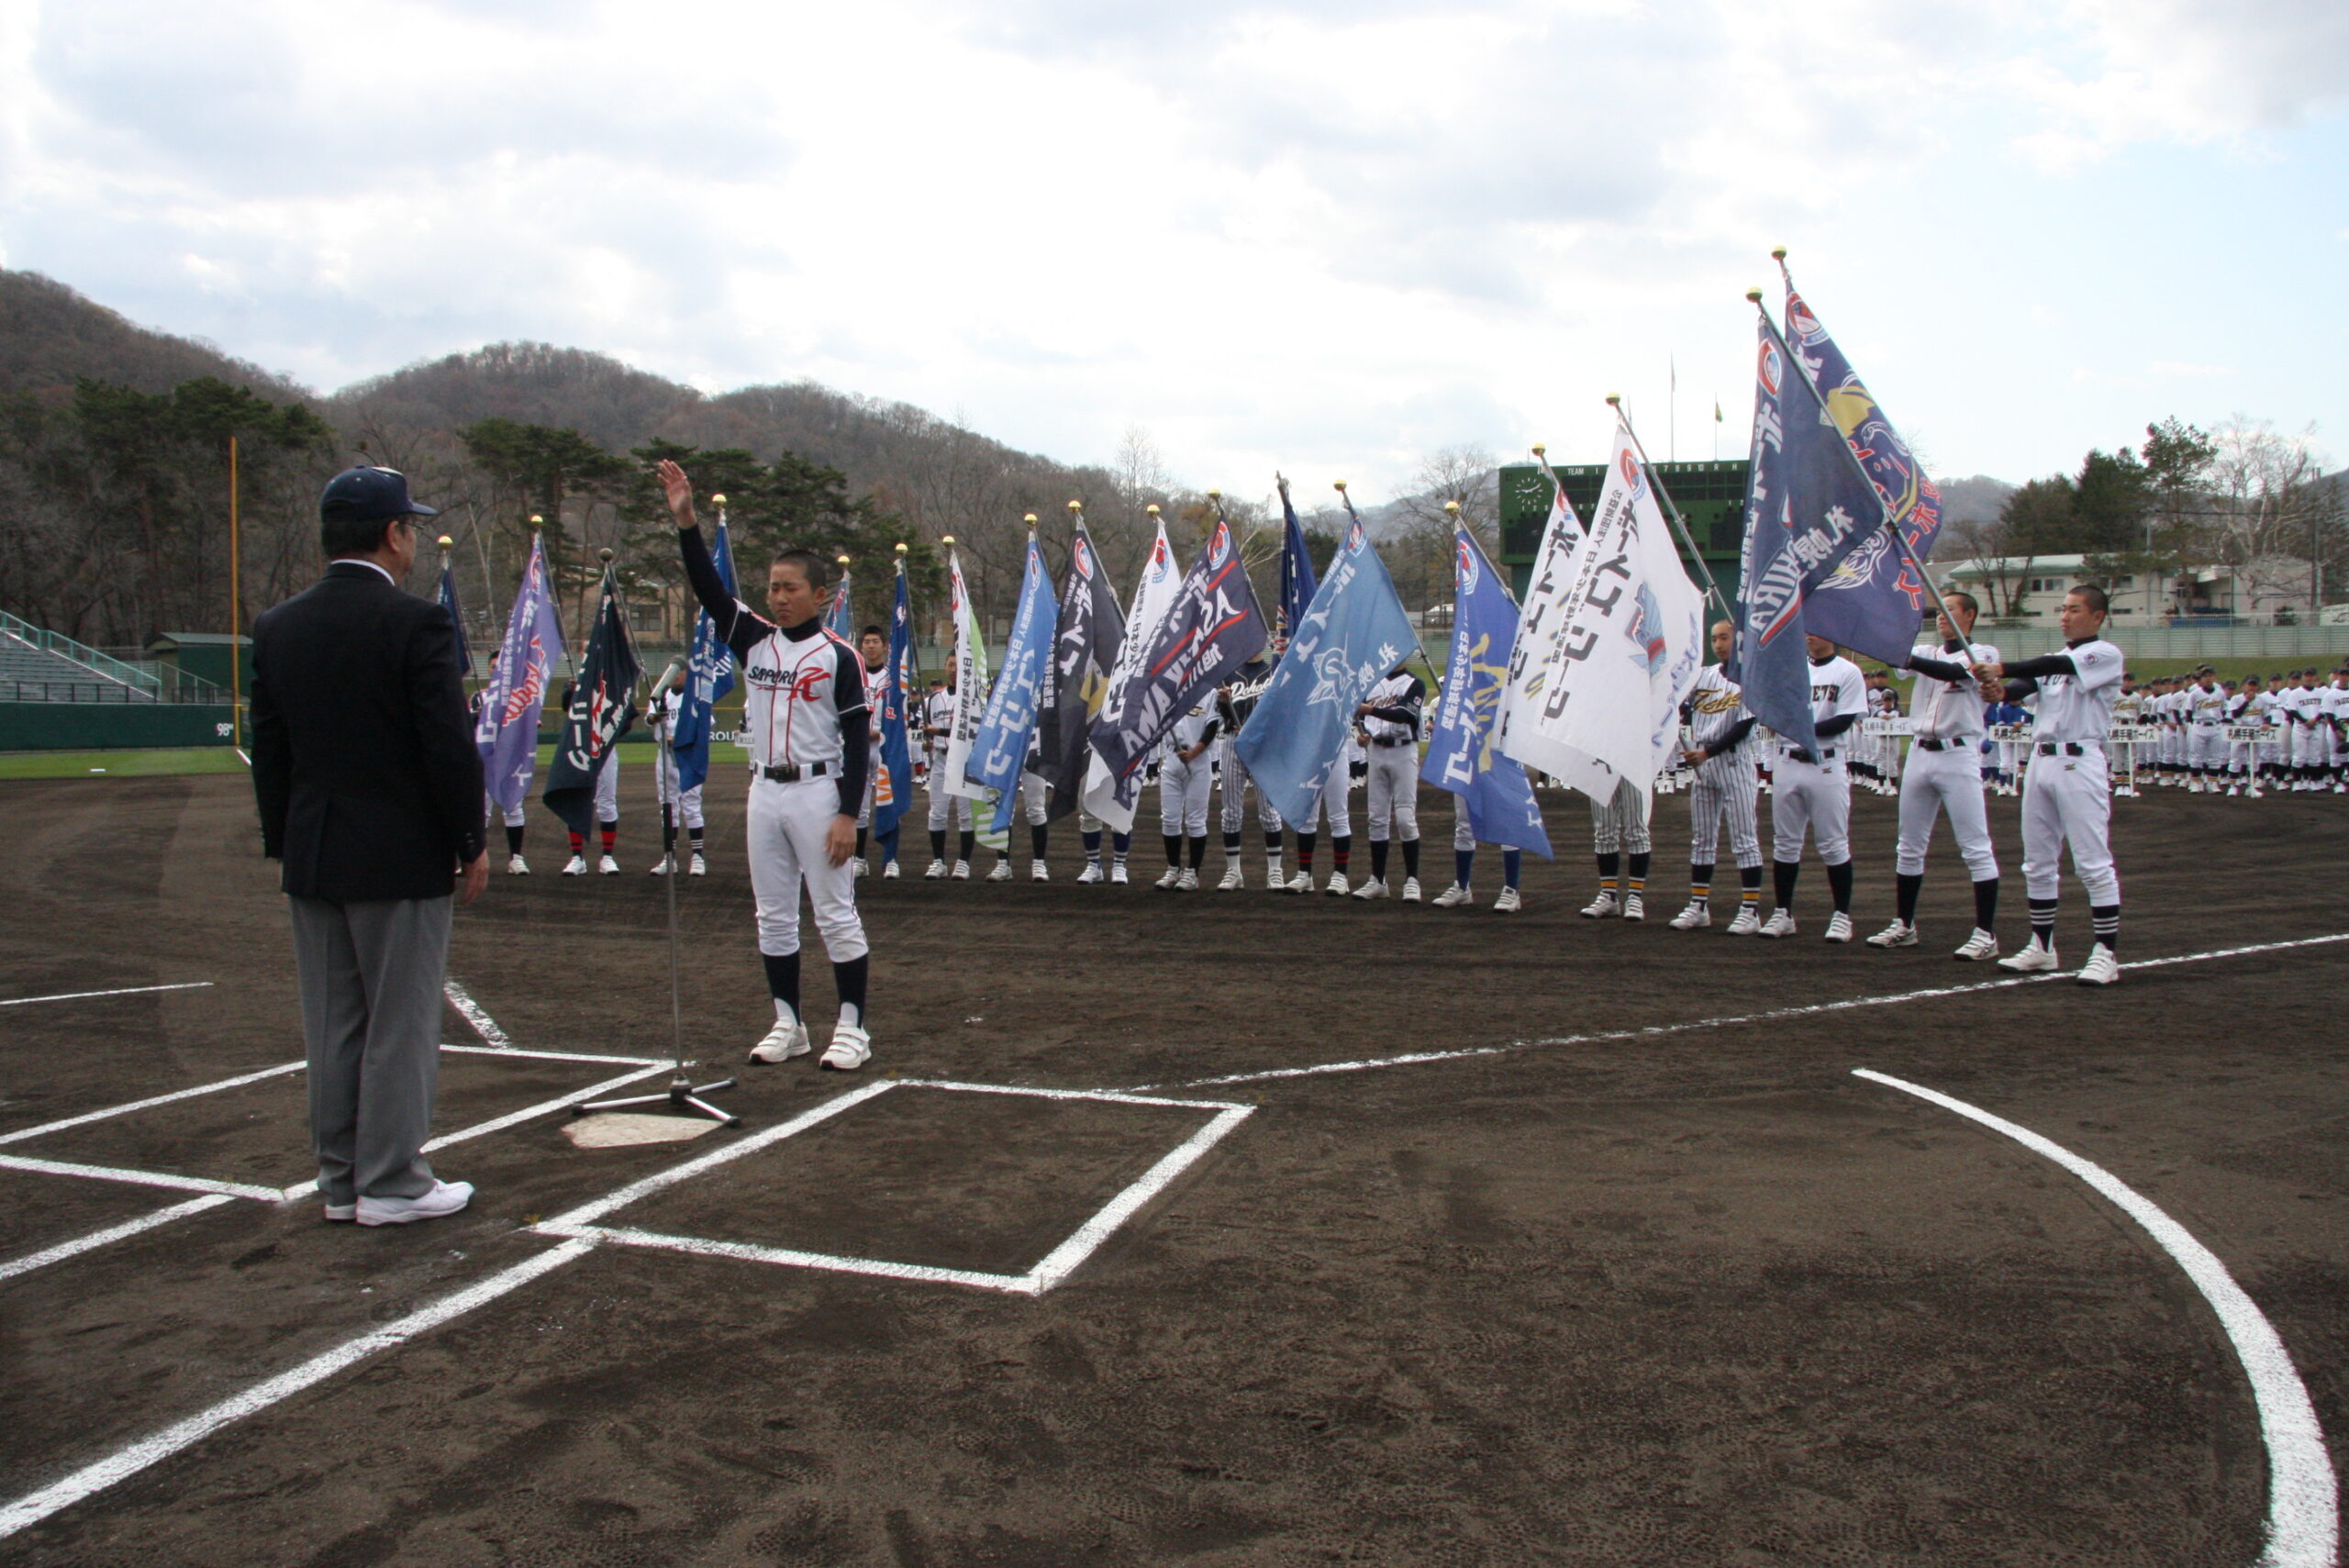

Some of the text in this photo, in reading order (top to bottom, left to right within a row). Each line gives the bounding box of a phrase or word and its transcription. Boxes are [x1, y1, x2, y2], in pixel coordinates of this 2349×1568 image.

[1567, 467, 1585, 476] TEAM
[1664, 464, 1668, 473] 7
[1675, 464, 1680, 473] 8
[1687, 464, 1692, 473] 9
[1698, 463, 1704, 473] 10
[1713, 462, 1719, 471] R
[1731, 462, 1738, 471] H
